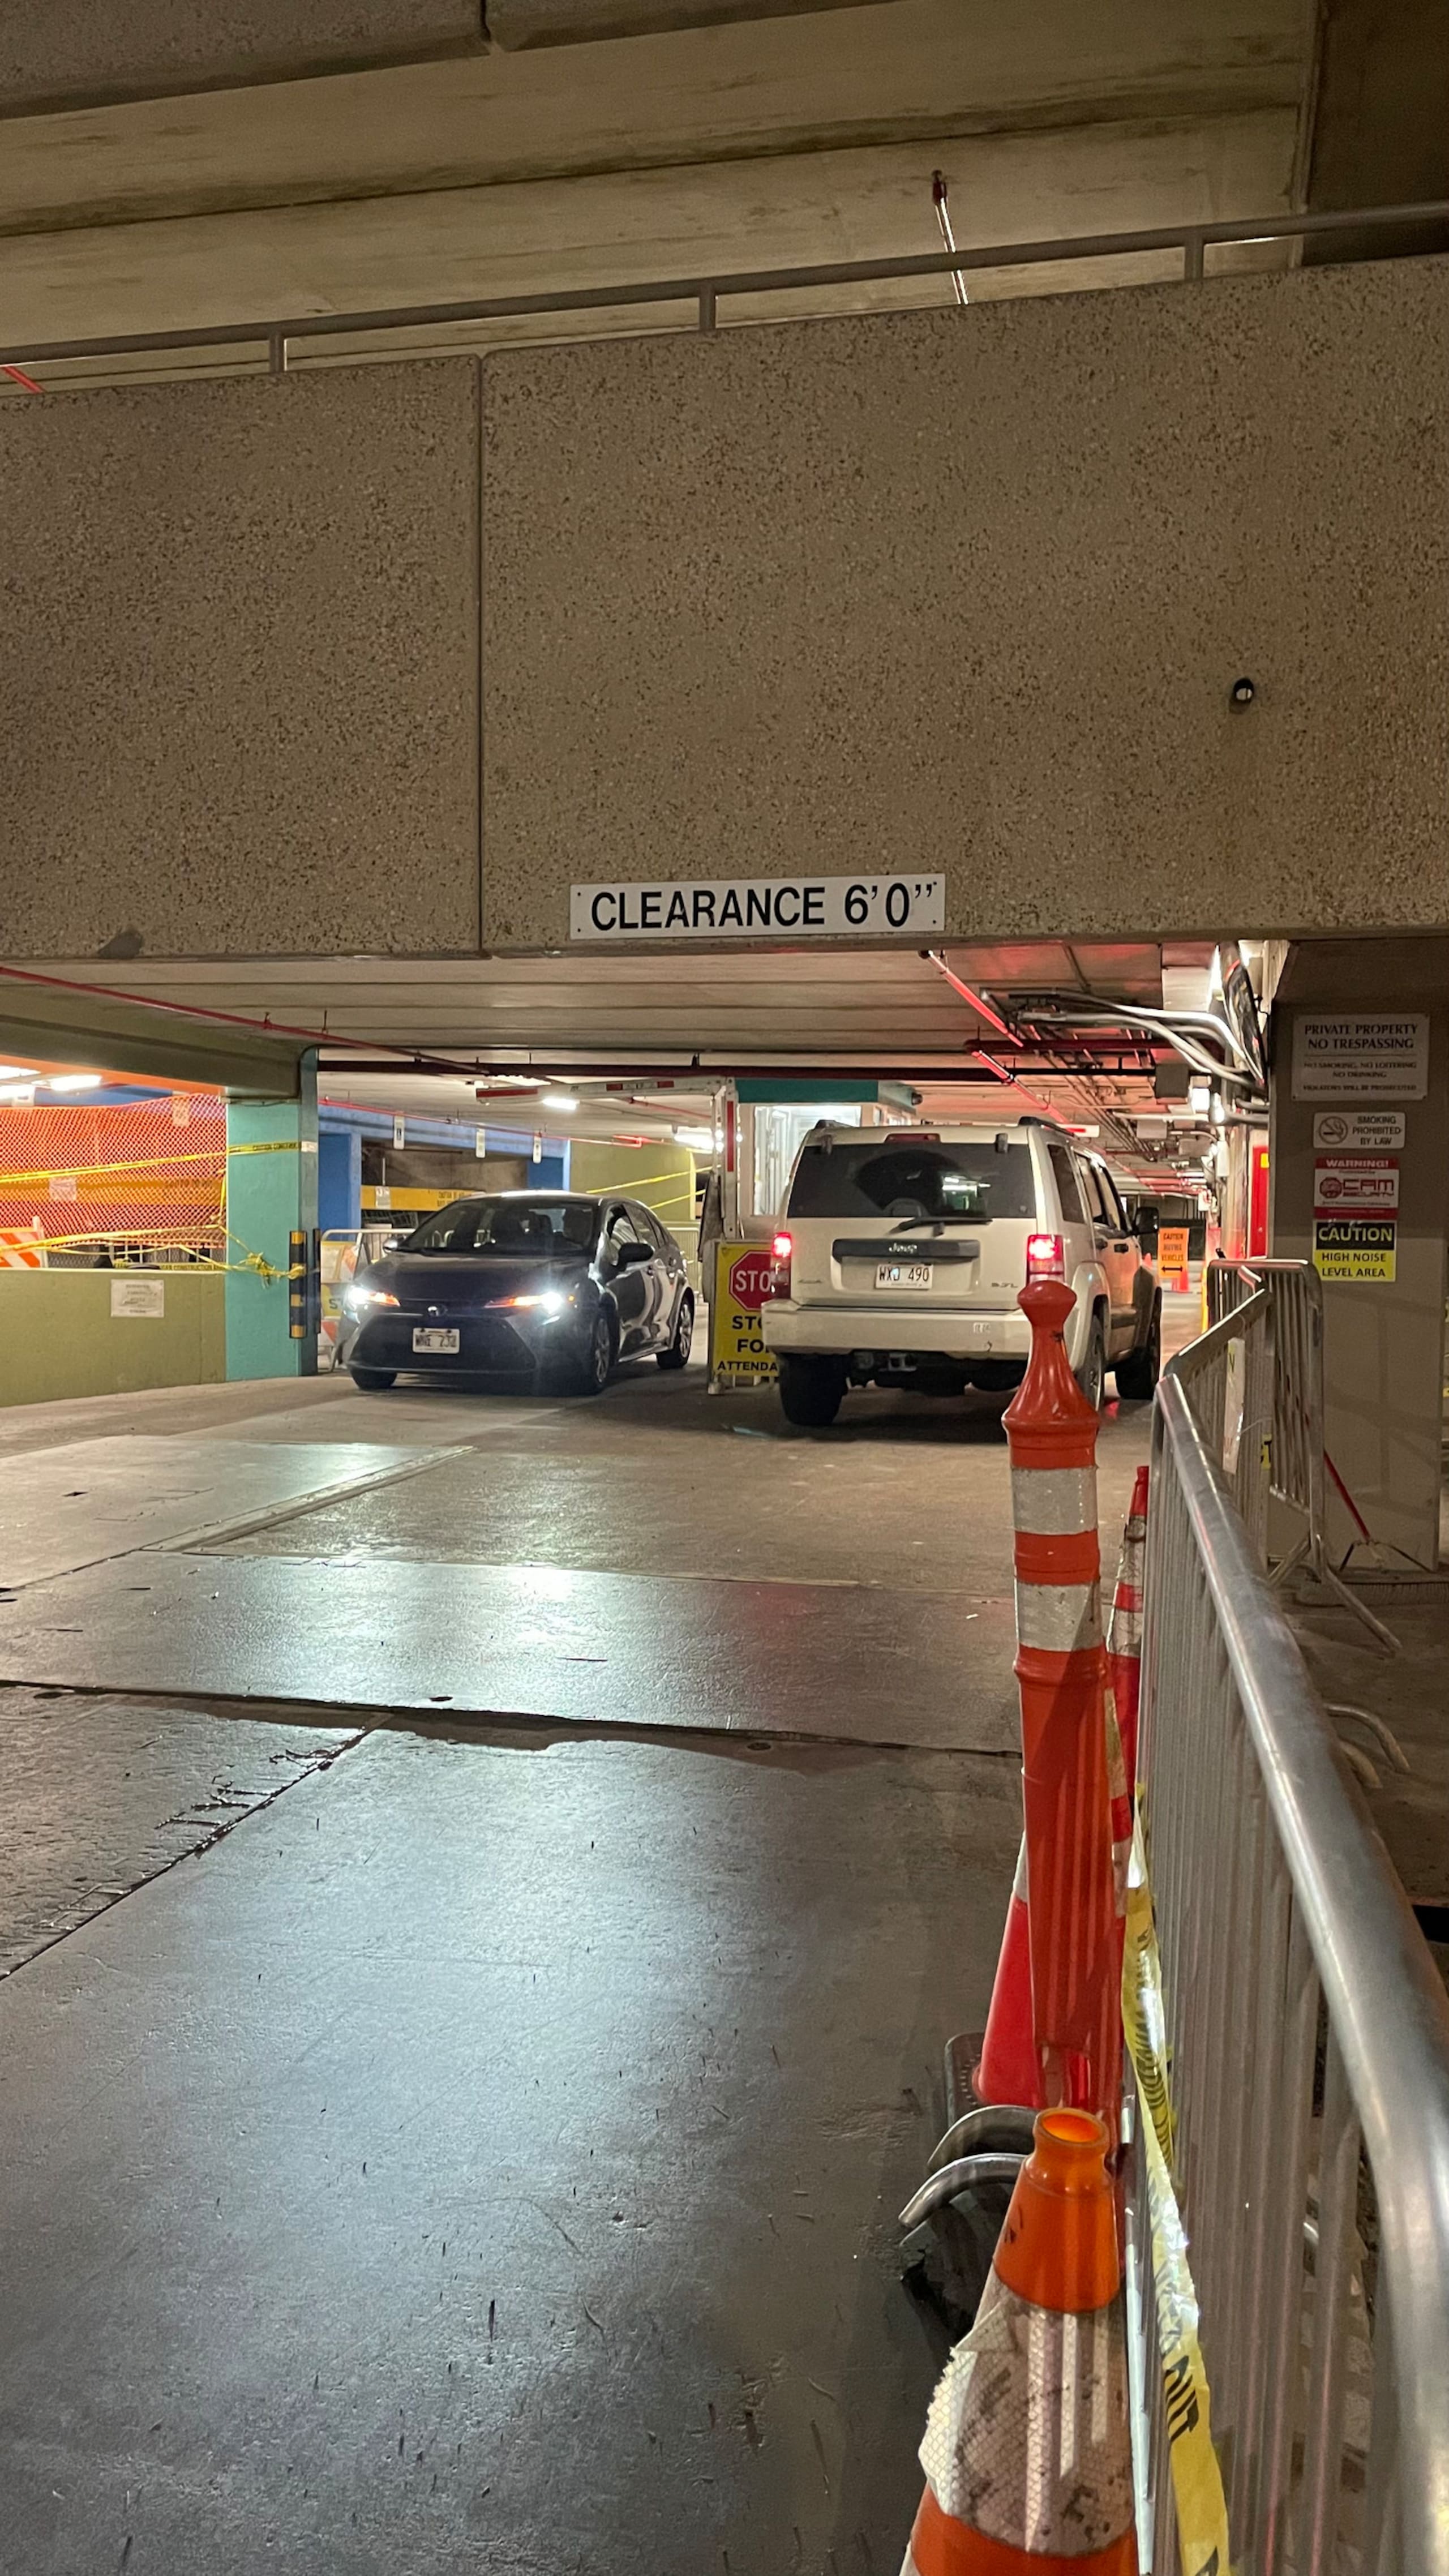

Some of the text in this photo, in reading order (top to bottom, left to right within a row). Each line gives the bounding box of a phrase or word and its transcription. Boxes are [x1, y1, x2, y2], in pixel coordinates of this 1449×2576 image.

[591, 886, 826, 931] CLEARANCE
[1304, 1023, 1418, 1035] PRIVATE PROPERTY
[1308, 1038, 1414, 1049] NO TRESPASSING
[1326, 1159, 1389, 1168] WARNING!
[1318, 1227, 1392, 1241] CAUTION
[1322, 1253, 1386, 1262] HIGH NOISE
[908, 1267, 929, 1281] 490
[1322, 1267, 1386, 1277] LEVEL AREA
[736, 1270, 771, 1292] STO
[737, 1339, 770, 1353] FO
[717, 1360, 778, 1371] ATTENDA
